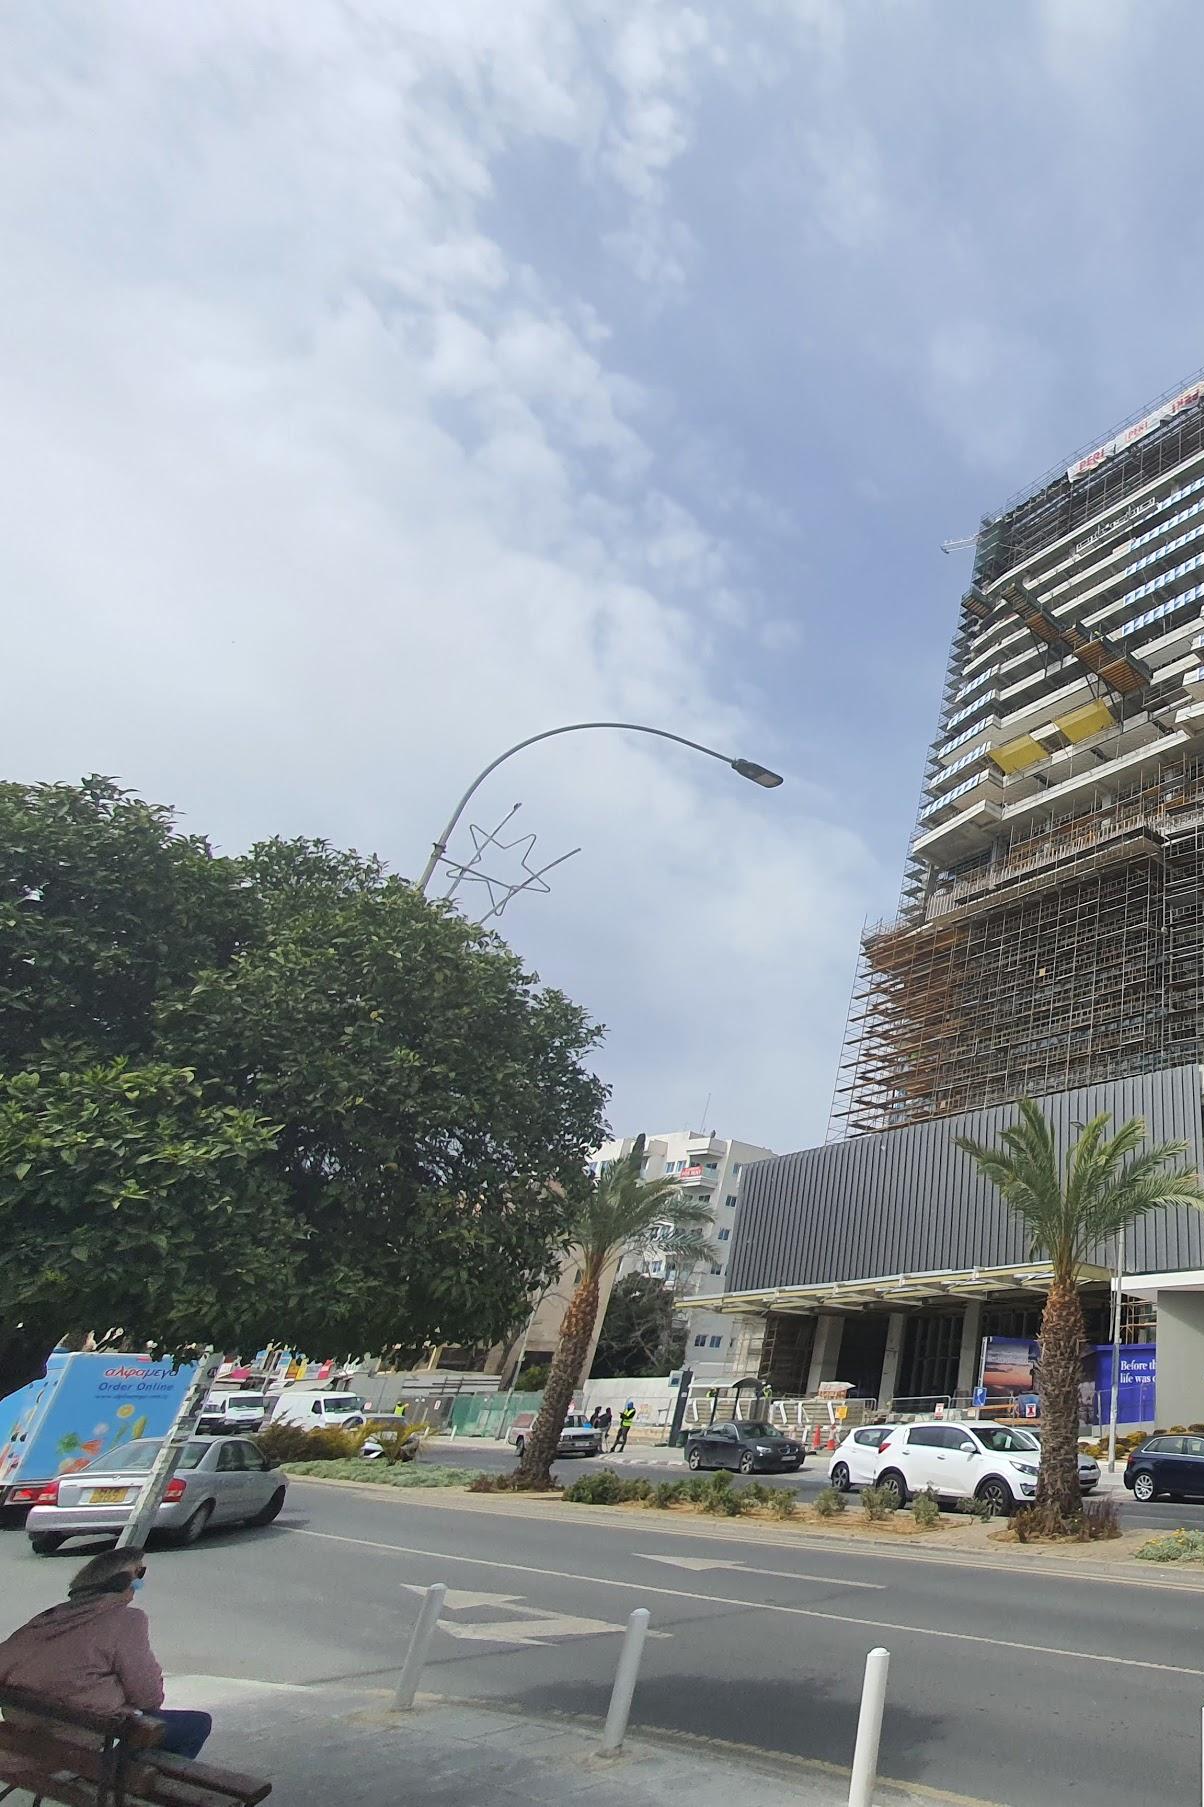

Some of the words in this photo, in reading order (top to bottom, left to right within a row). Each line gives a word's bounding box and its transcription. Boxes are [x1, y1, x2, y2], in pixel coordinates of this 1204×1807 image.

[1079, 448, 1105, 471] PERI
[1120, 1360, 1148, 1371] Before
[1120, 1373, 1133, 1383] life
[98, 1382, 132, 1392] Order
[138, 1382, 174, 1392] Online
